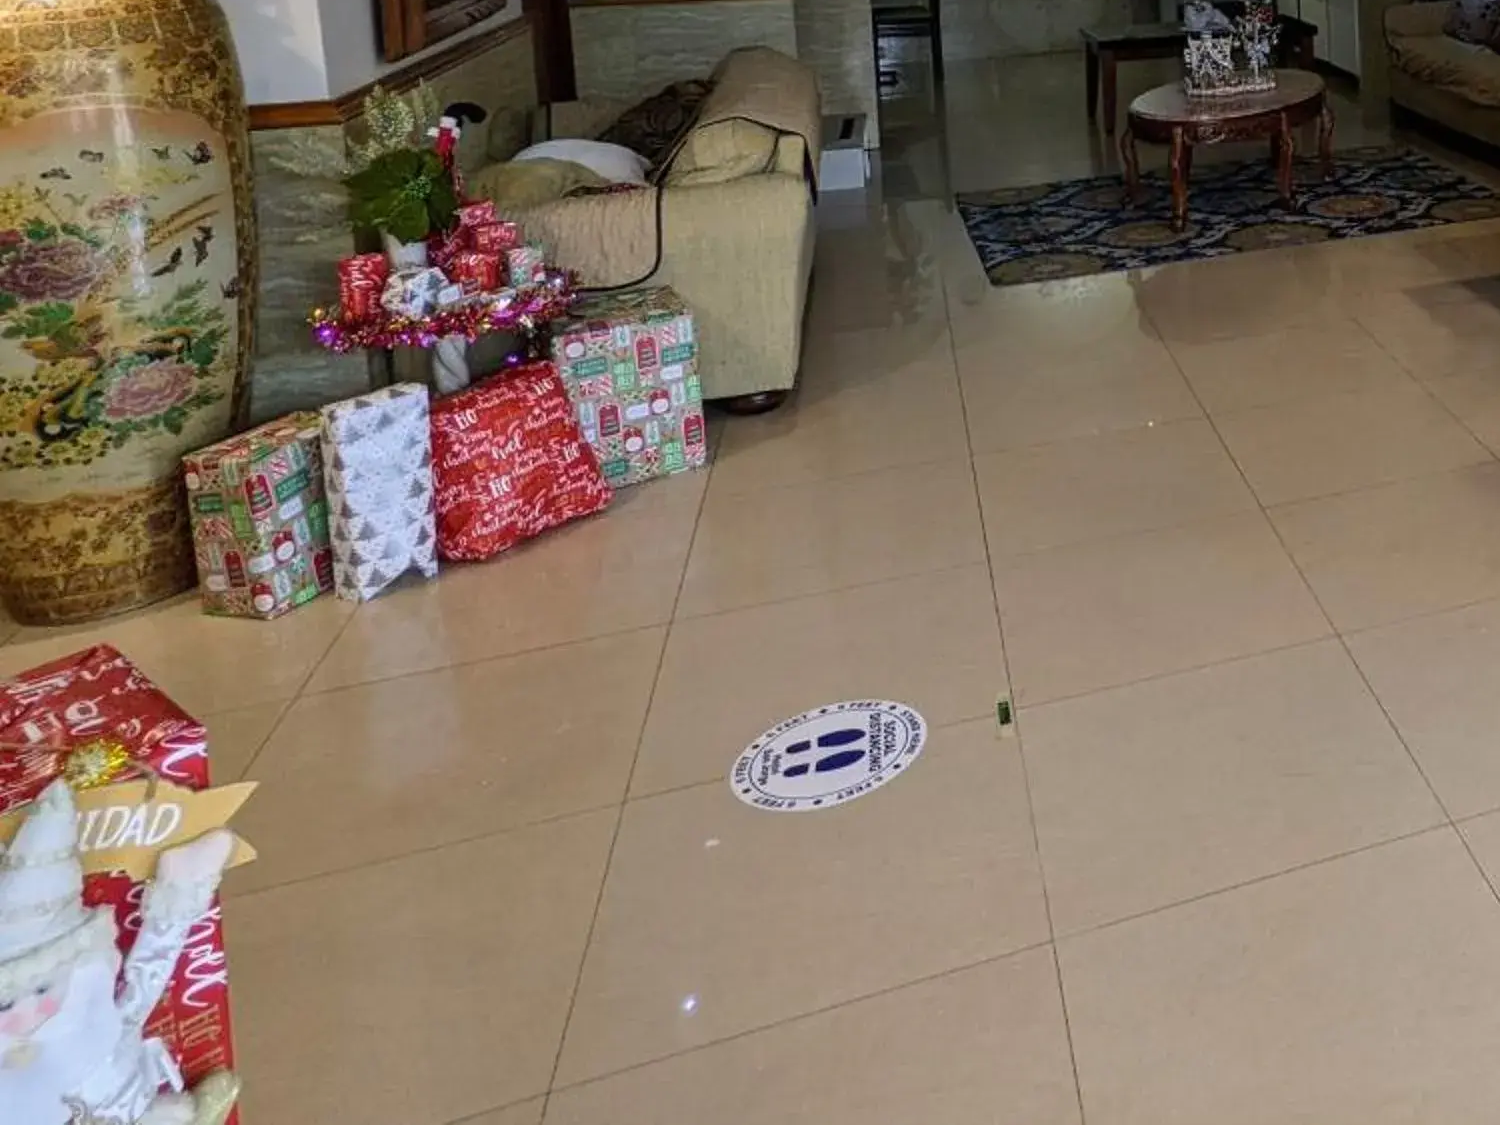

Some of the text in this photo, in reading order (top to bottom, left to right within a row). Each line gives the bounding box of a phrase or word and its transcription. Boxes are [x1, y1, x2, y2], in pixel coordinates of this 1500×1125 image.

[868, 712, 882, 773] DISTANCING
[882, 719, 897, 757] SOCIAL
[77, 802, 183, 852] IDAD
